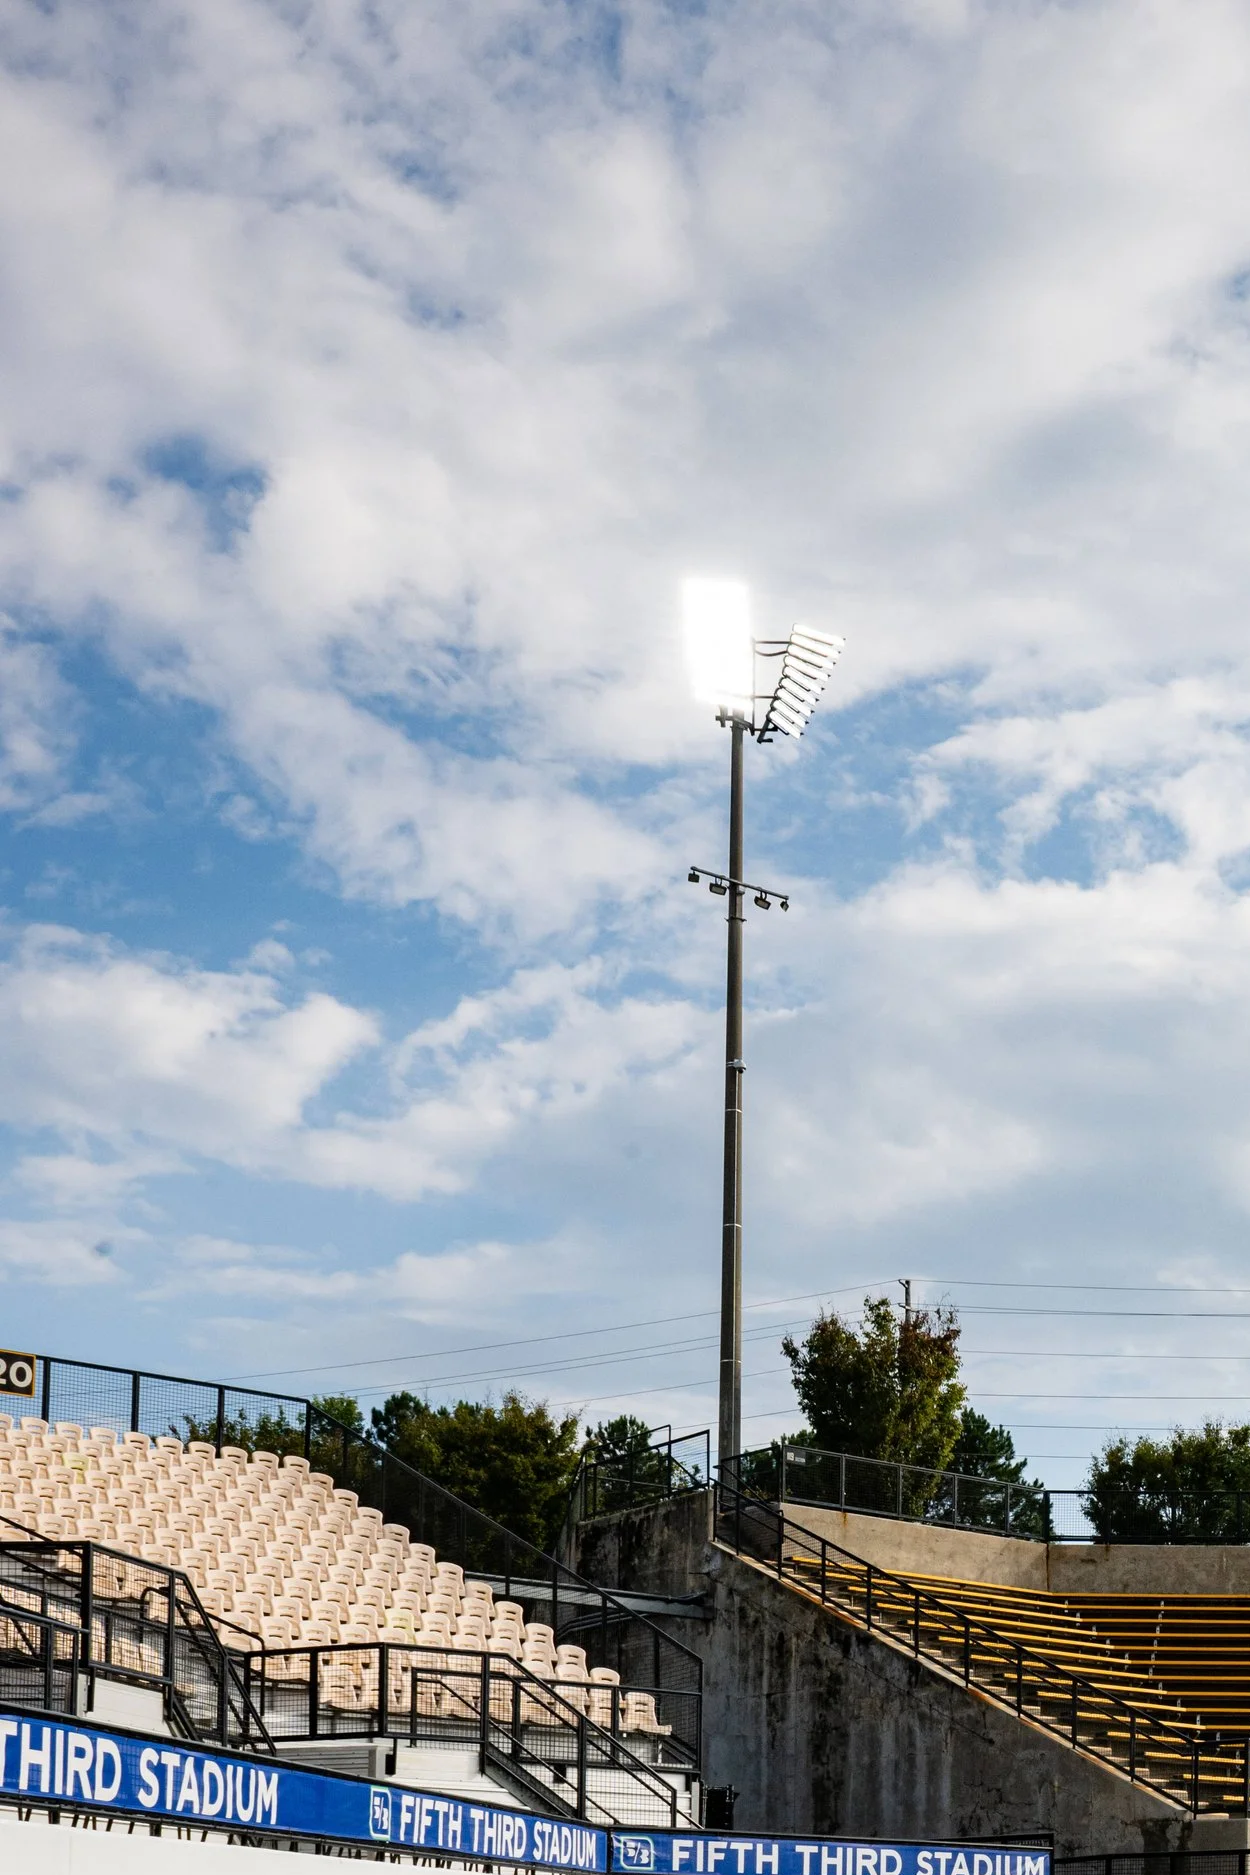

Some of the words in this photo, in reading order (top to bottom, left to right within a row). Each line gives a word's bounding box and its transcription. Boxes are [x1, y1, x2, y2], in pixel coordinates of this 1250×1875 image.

[0, 1718, 122, 1802] THIRD
[137, 1747, 279, 1825] STADIUM
[400, 1794, 462, 1849] FIFTH
[470, 1808, 527, 1859] THIRD
[533, 1820, 597, 1869] STADIUM
[672, 1839, 779, 1875] FIFTH
